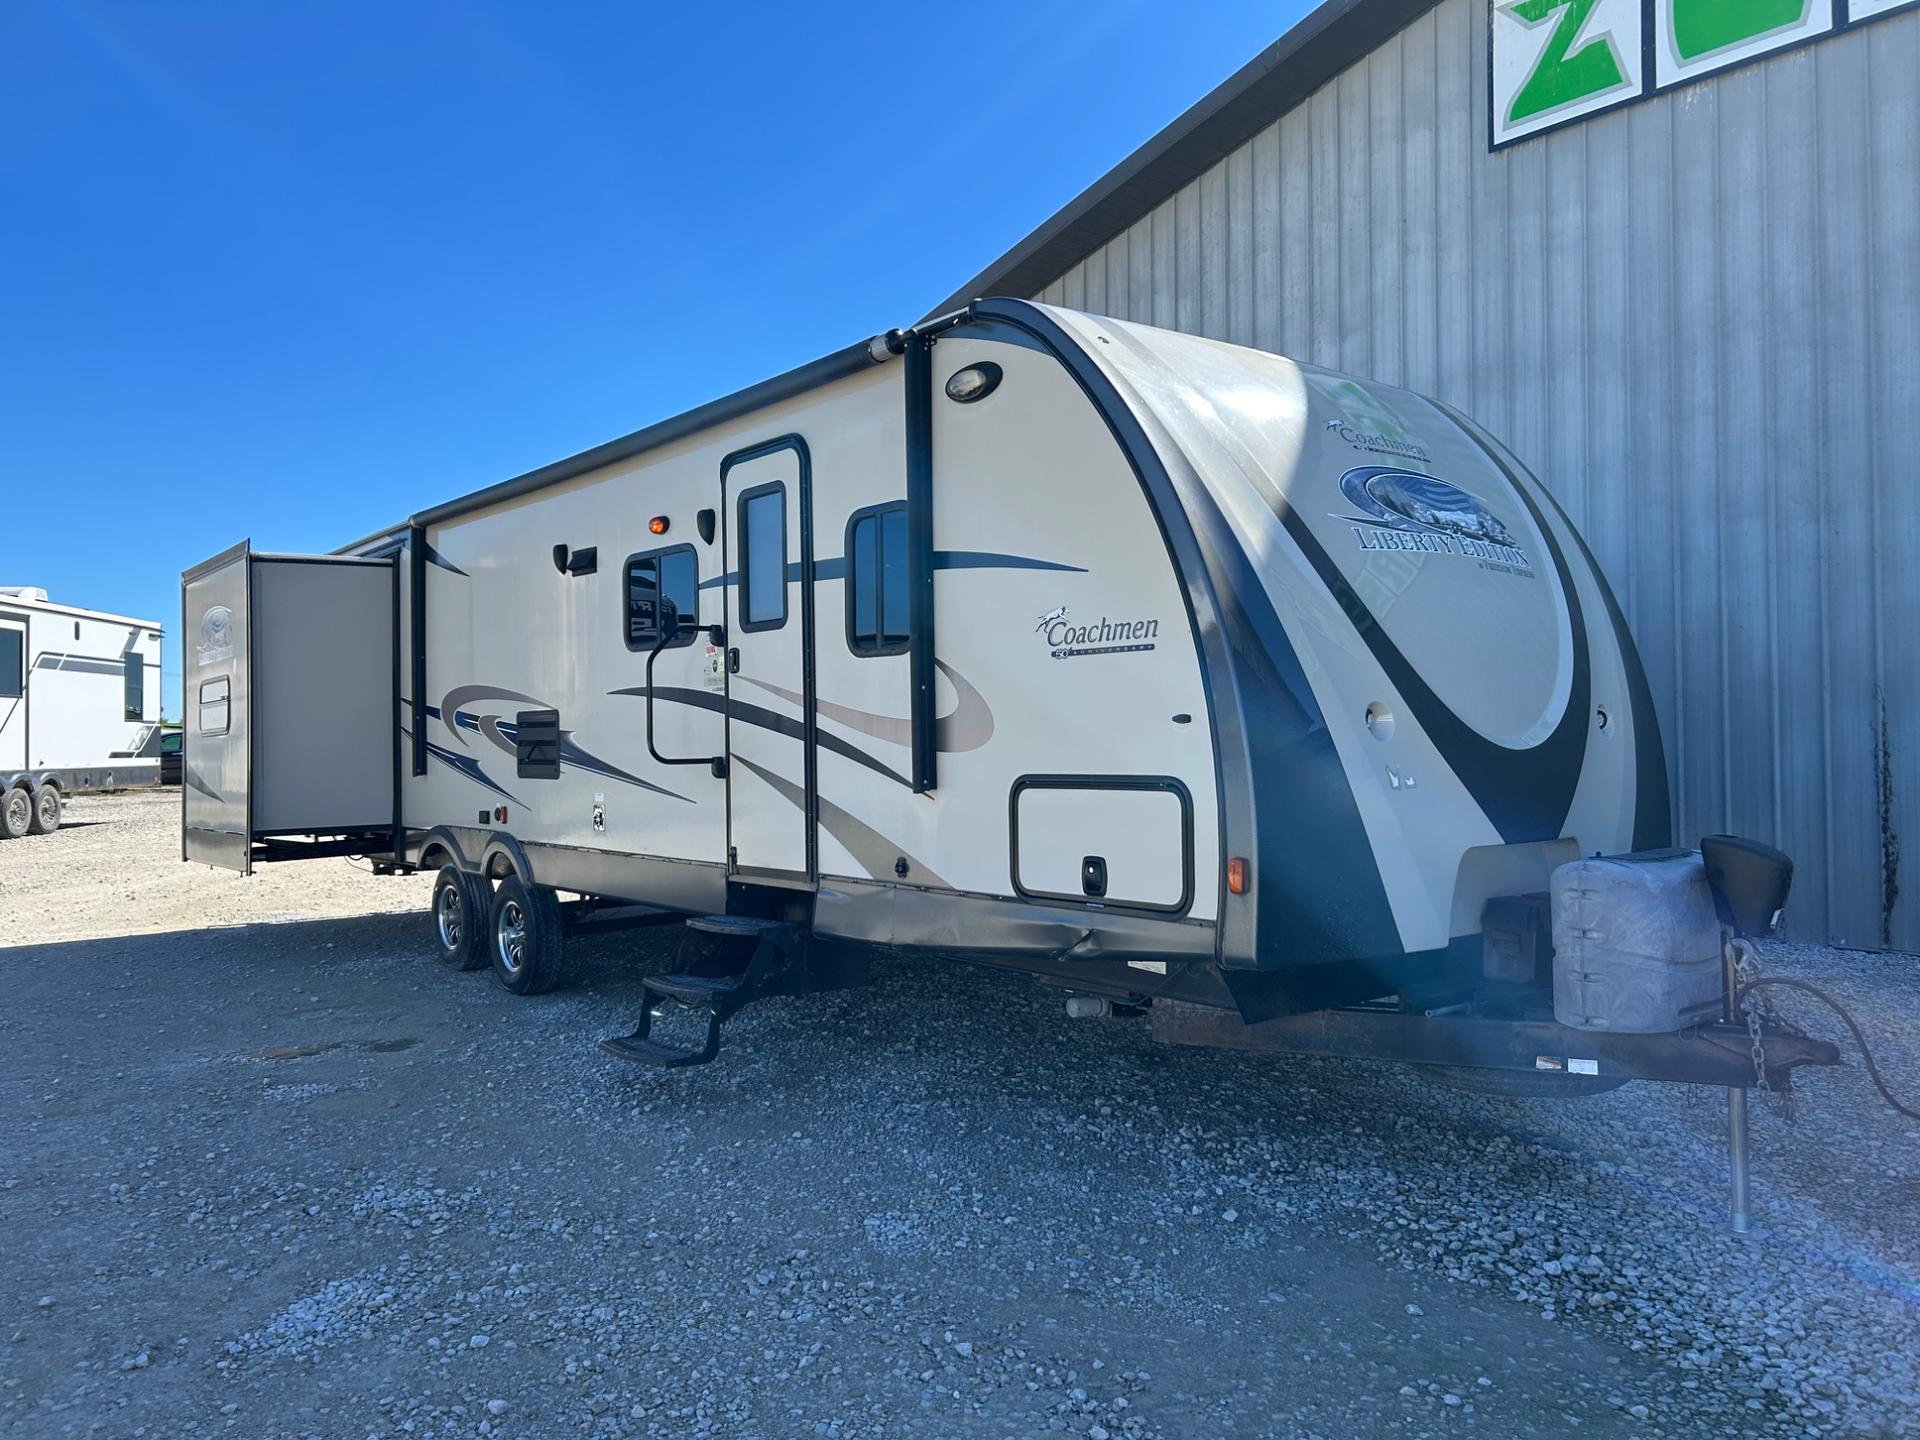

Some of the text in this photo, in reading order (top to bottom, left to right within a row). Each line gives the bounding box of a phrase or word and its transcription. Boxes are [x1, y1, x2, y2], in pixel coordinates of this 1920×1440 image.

[1340, 427, 1426, 457] Coachmen
[1352, 528, 1532, 568] LIBERTY EDITION
[1047, 616, 1159, 647] Coachmen
